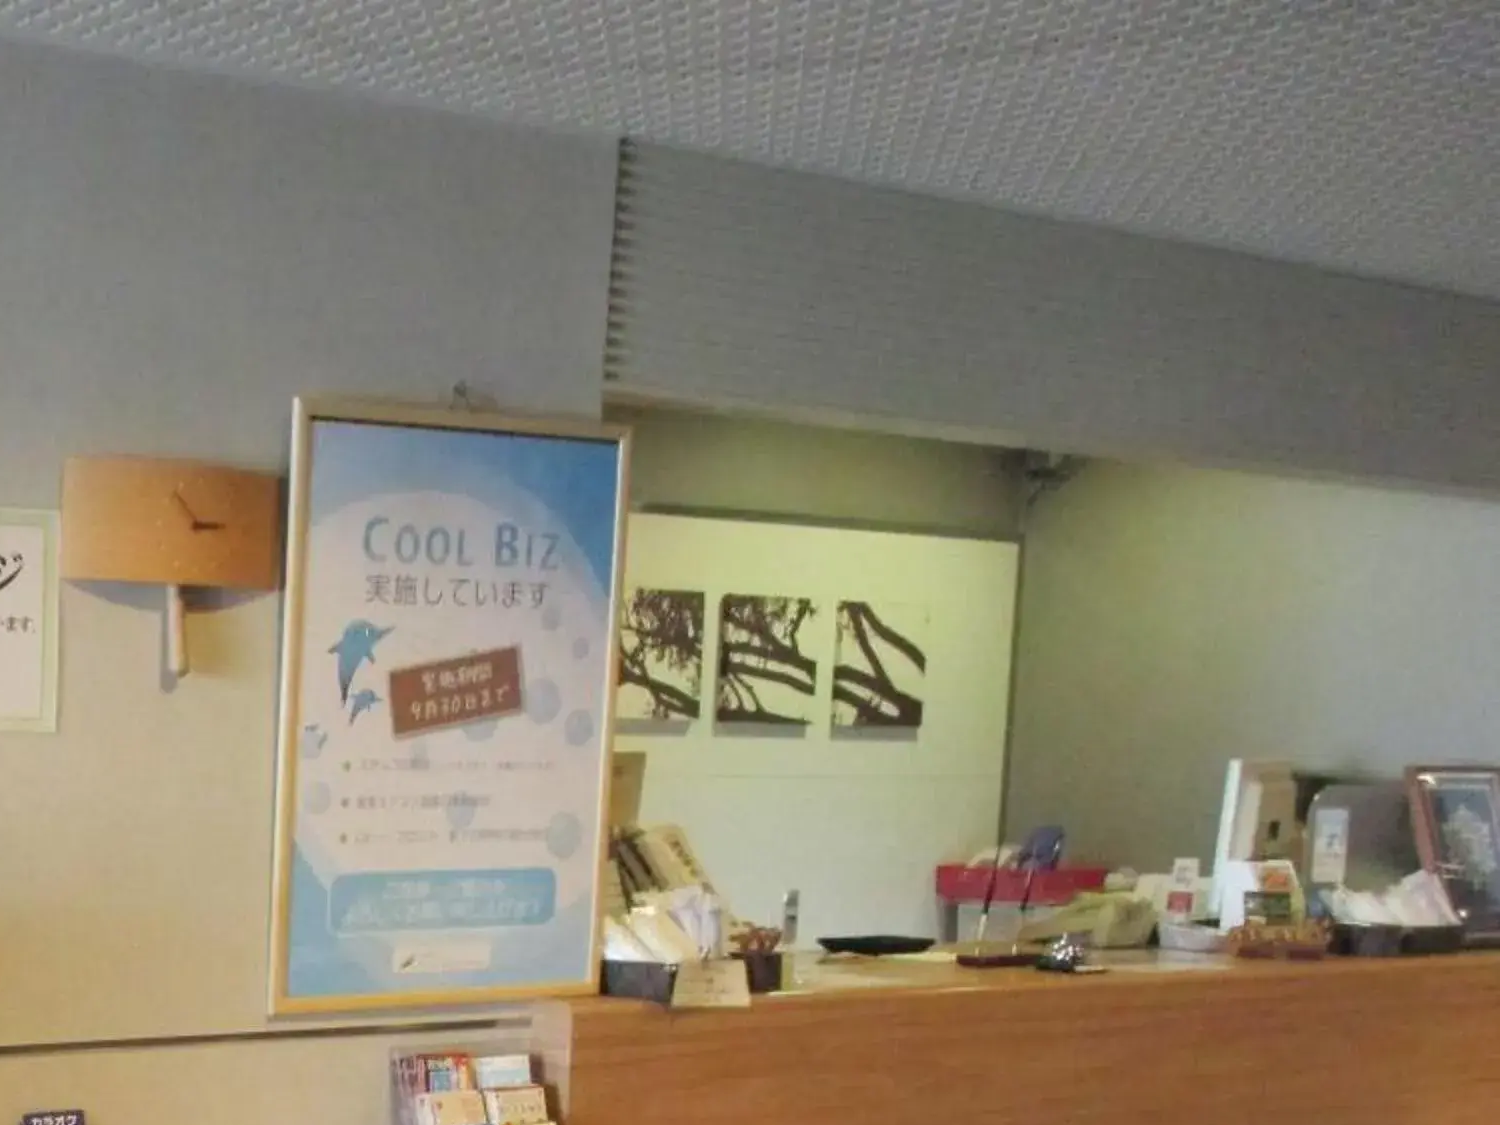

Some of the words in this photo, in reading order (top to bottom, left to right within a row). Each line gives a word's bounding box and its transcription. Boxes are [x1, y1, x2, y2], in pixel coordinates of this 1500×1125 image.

[362, 515, 473, 567] COOL
[494, 521, 561, 571] BIZ
[365, 573, 549, 609] 実施しています
